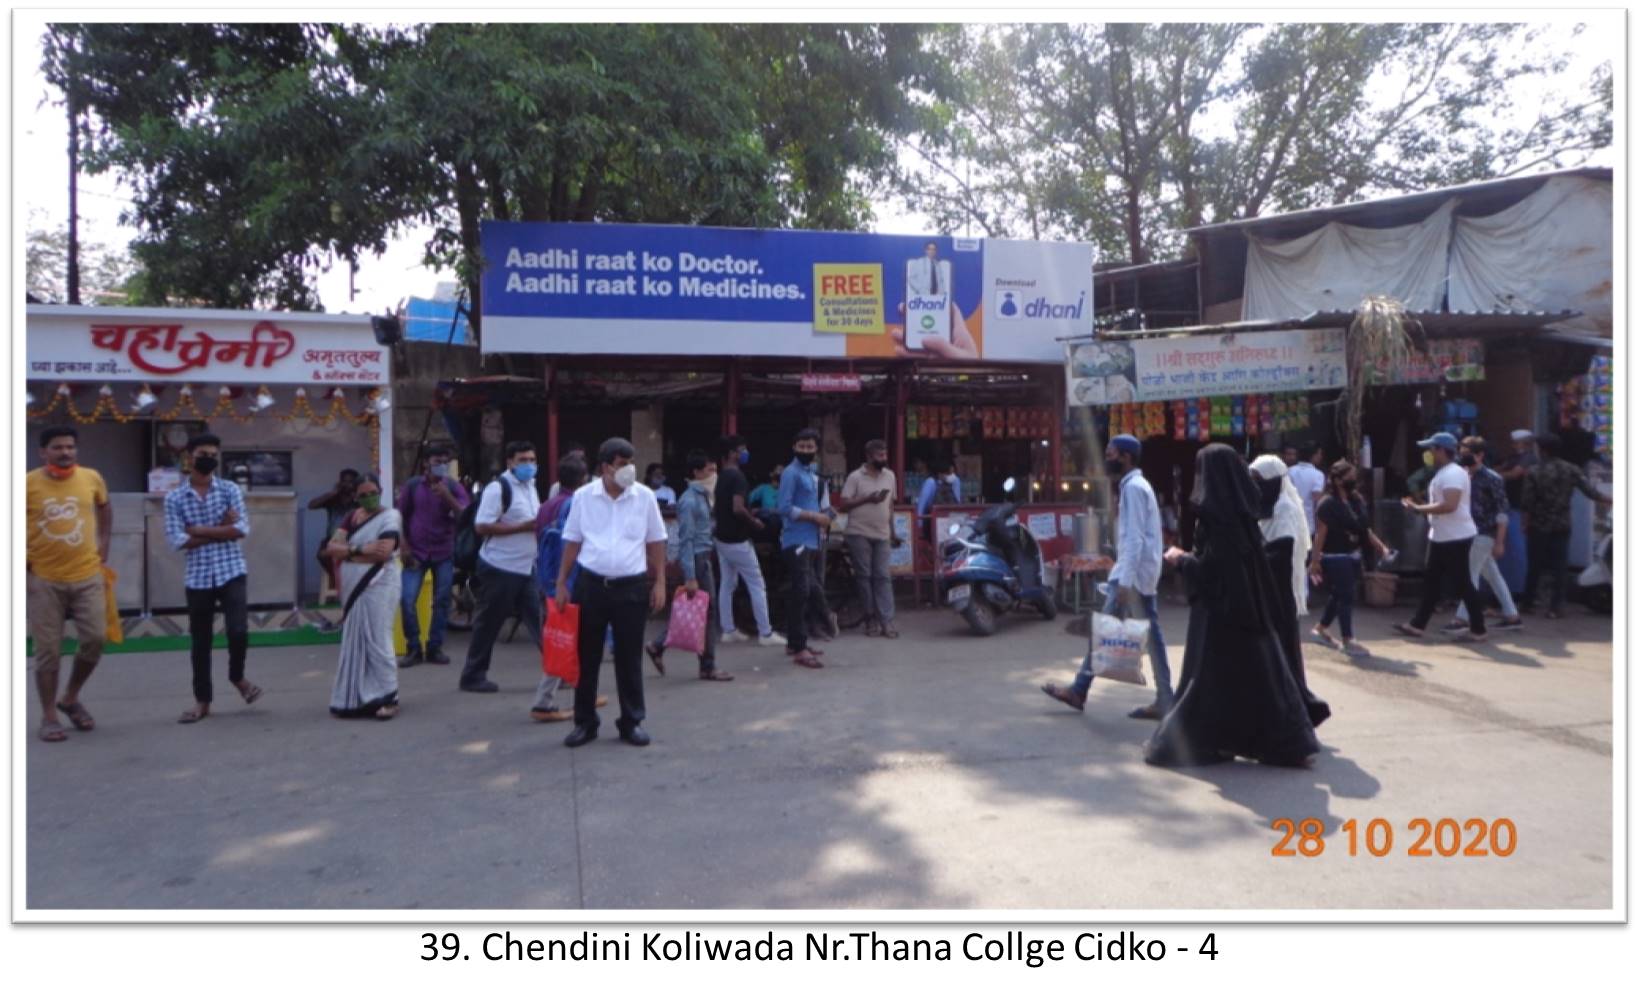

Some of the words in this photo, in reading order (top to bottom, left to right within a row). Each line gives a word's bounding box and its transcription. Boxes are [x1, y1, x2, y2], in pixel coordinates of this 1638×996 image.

[505, 248, 578, 270] Aadhi
[585, 251, 636, 271] raat
[643, 251, 672, 272] ko
[678, 252, 763, 275] Doctor.
[505, 272, 579, 294] Aadhi
[585, 275, 636, 296] raat
[643, 275, 672, 297] ko
[679, 276, 805, 300] Medicines.
[821, 274, 874, 295] FREE
[995, 277, 1037, 287] Download
[823, 307, 831, 316] &
[832, 307, 876, 316] Medicines
[908, 292, 947, 312] dhani
[1025, 290, 1086, 320] dhani
[826, 317, 840, 327] for
[854, 317, 873, 328] days
[90, 324, 193, 375] चहा
[177, 321, 295, 369] प्रेमी
[303, 348, 382, 368] अमृततुल्य
